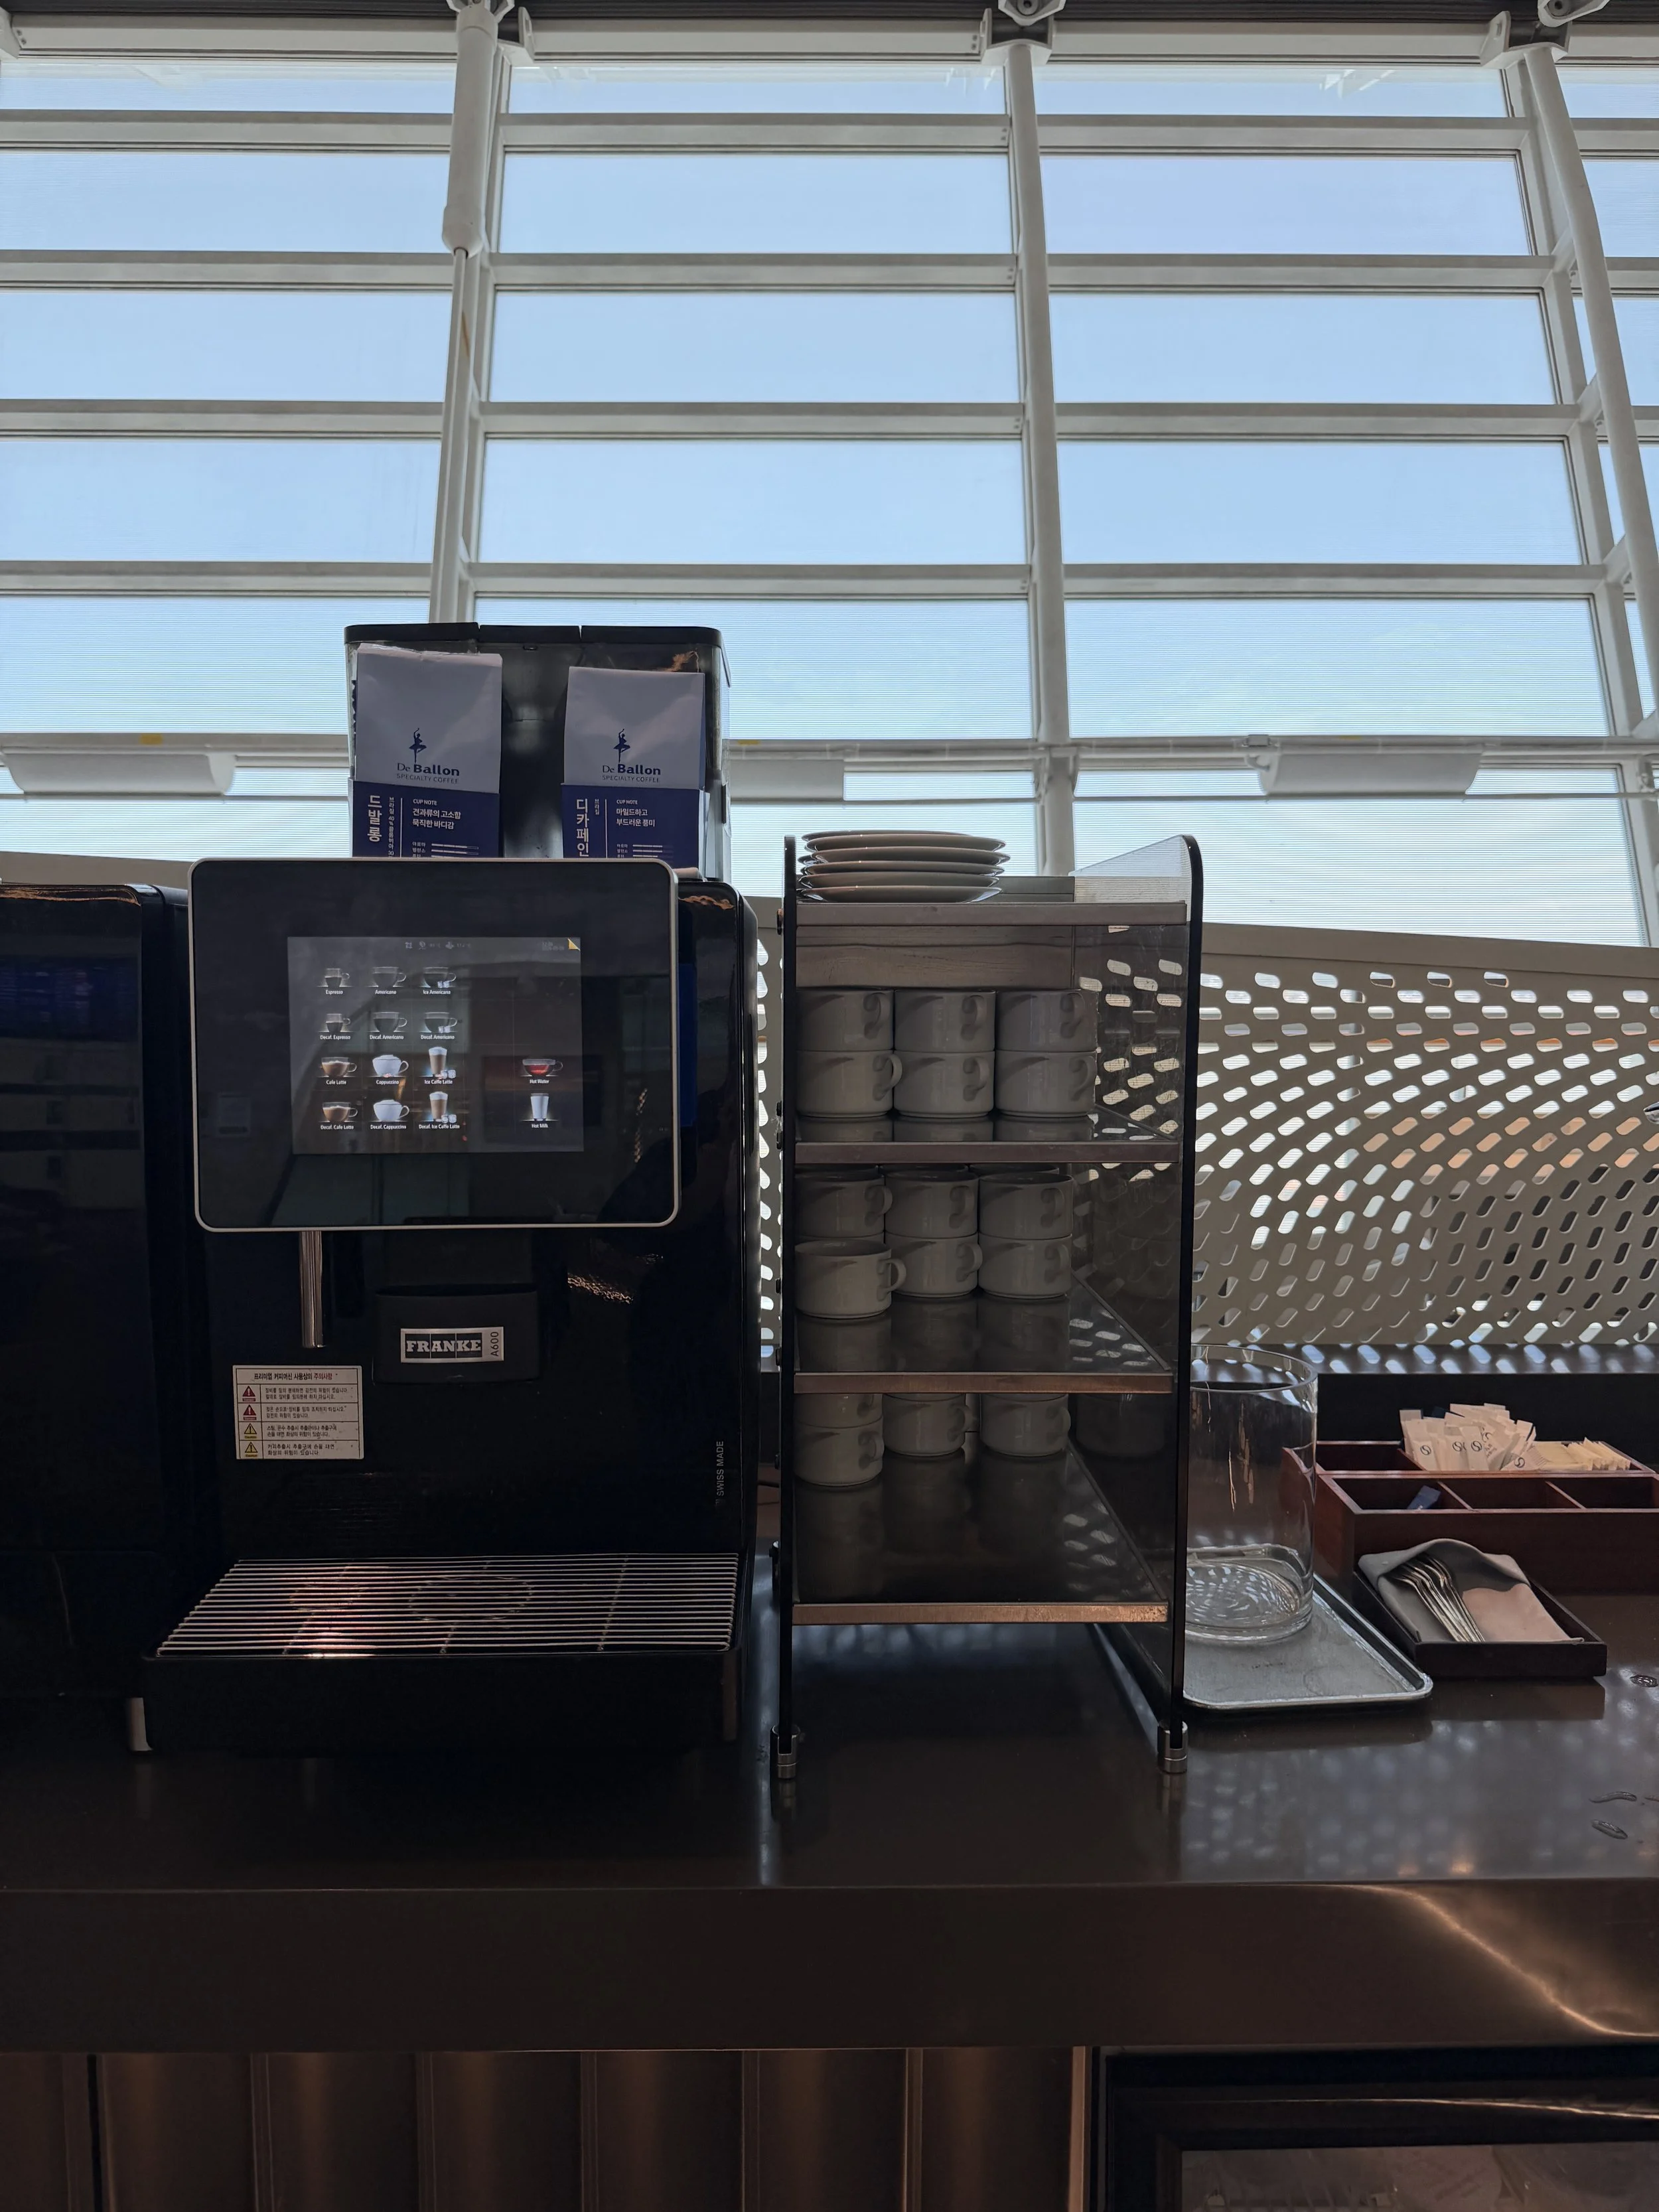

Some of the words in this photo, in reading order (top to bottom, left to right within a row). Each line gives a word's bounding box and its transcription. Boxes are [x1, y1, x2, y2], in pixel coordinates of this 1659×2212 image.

[397, 763, 411, 772] De
[413, 764, 460, 776] Ballon
[618, 764, 661, 775] Ballon
[397, 773, 431, 782] SPECIALTY
[413, 808, 440, 818] 견과류의
[441, 810, 461, 820] 고소함
[616, 808, 648, 816] 마일드하고
[367, 795, 382, 842] 드발롱
[412, 818, 433, 828] 묵직한
[434, 820, 455, 830] 바디감
[616, 818, 642, 827] 부드러운
[642, 819, 656, 828] 풍미
[576, 798, 589, 857] 디카페인
[406, 1340, 481, 1352] FRANKE
[490, 1331, 499, 1357] A600
